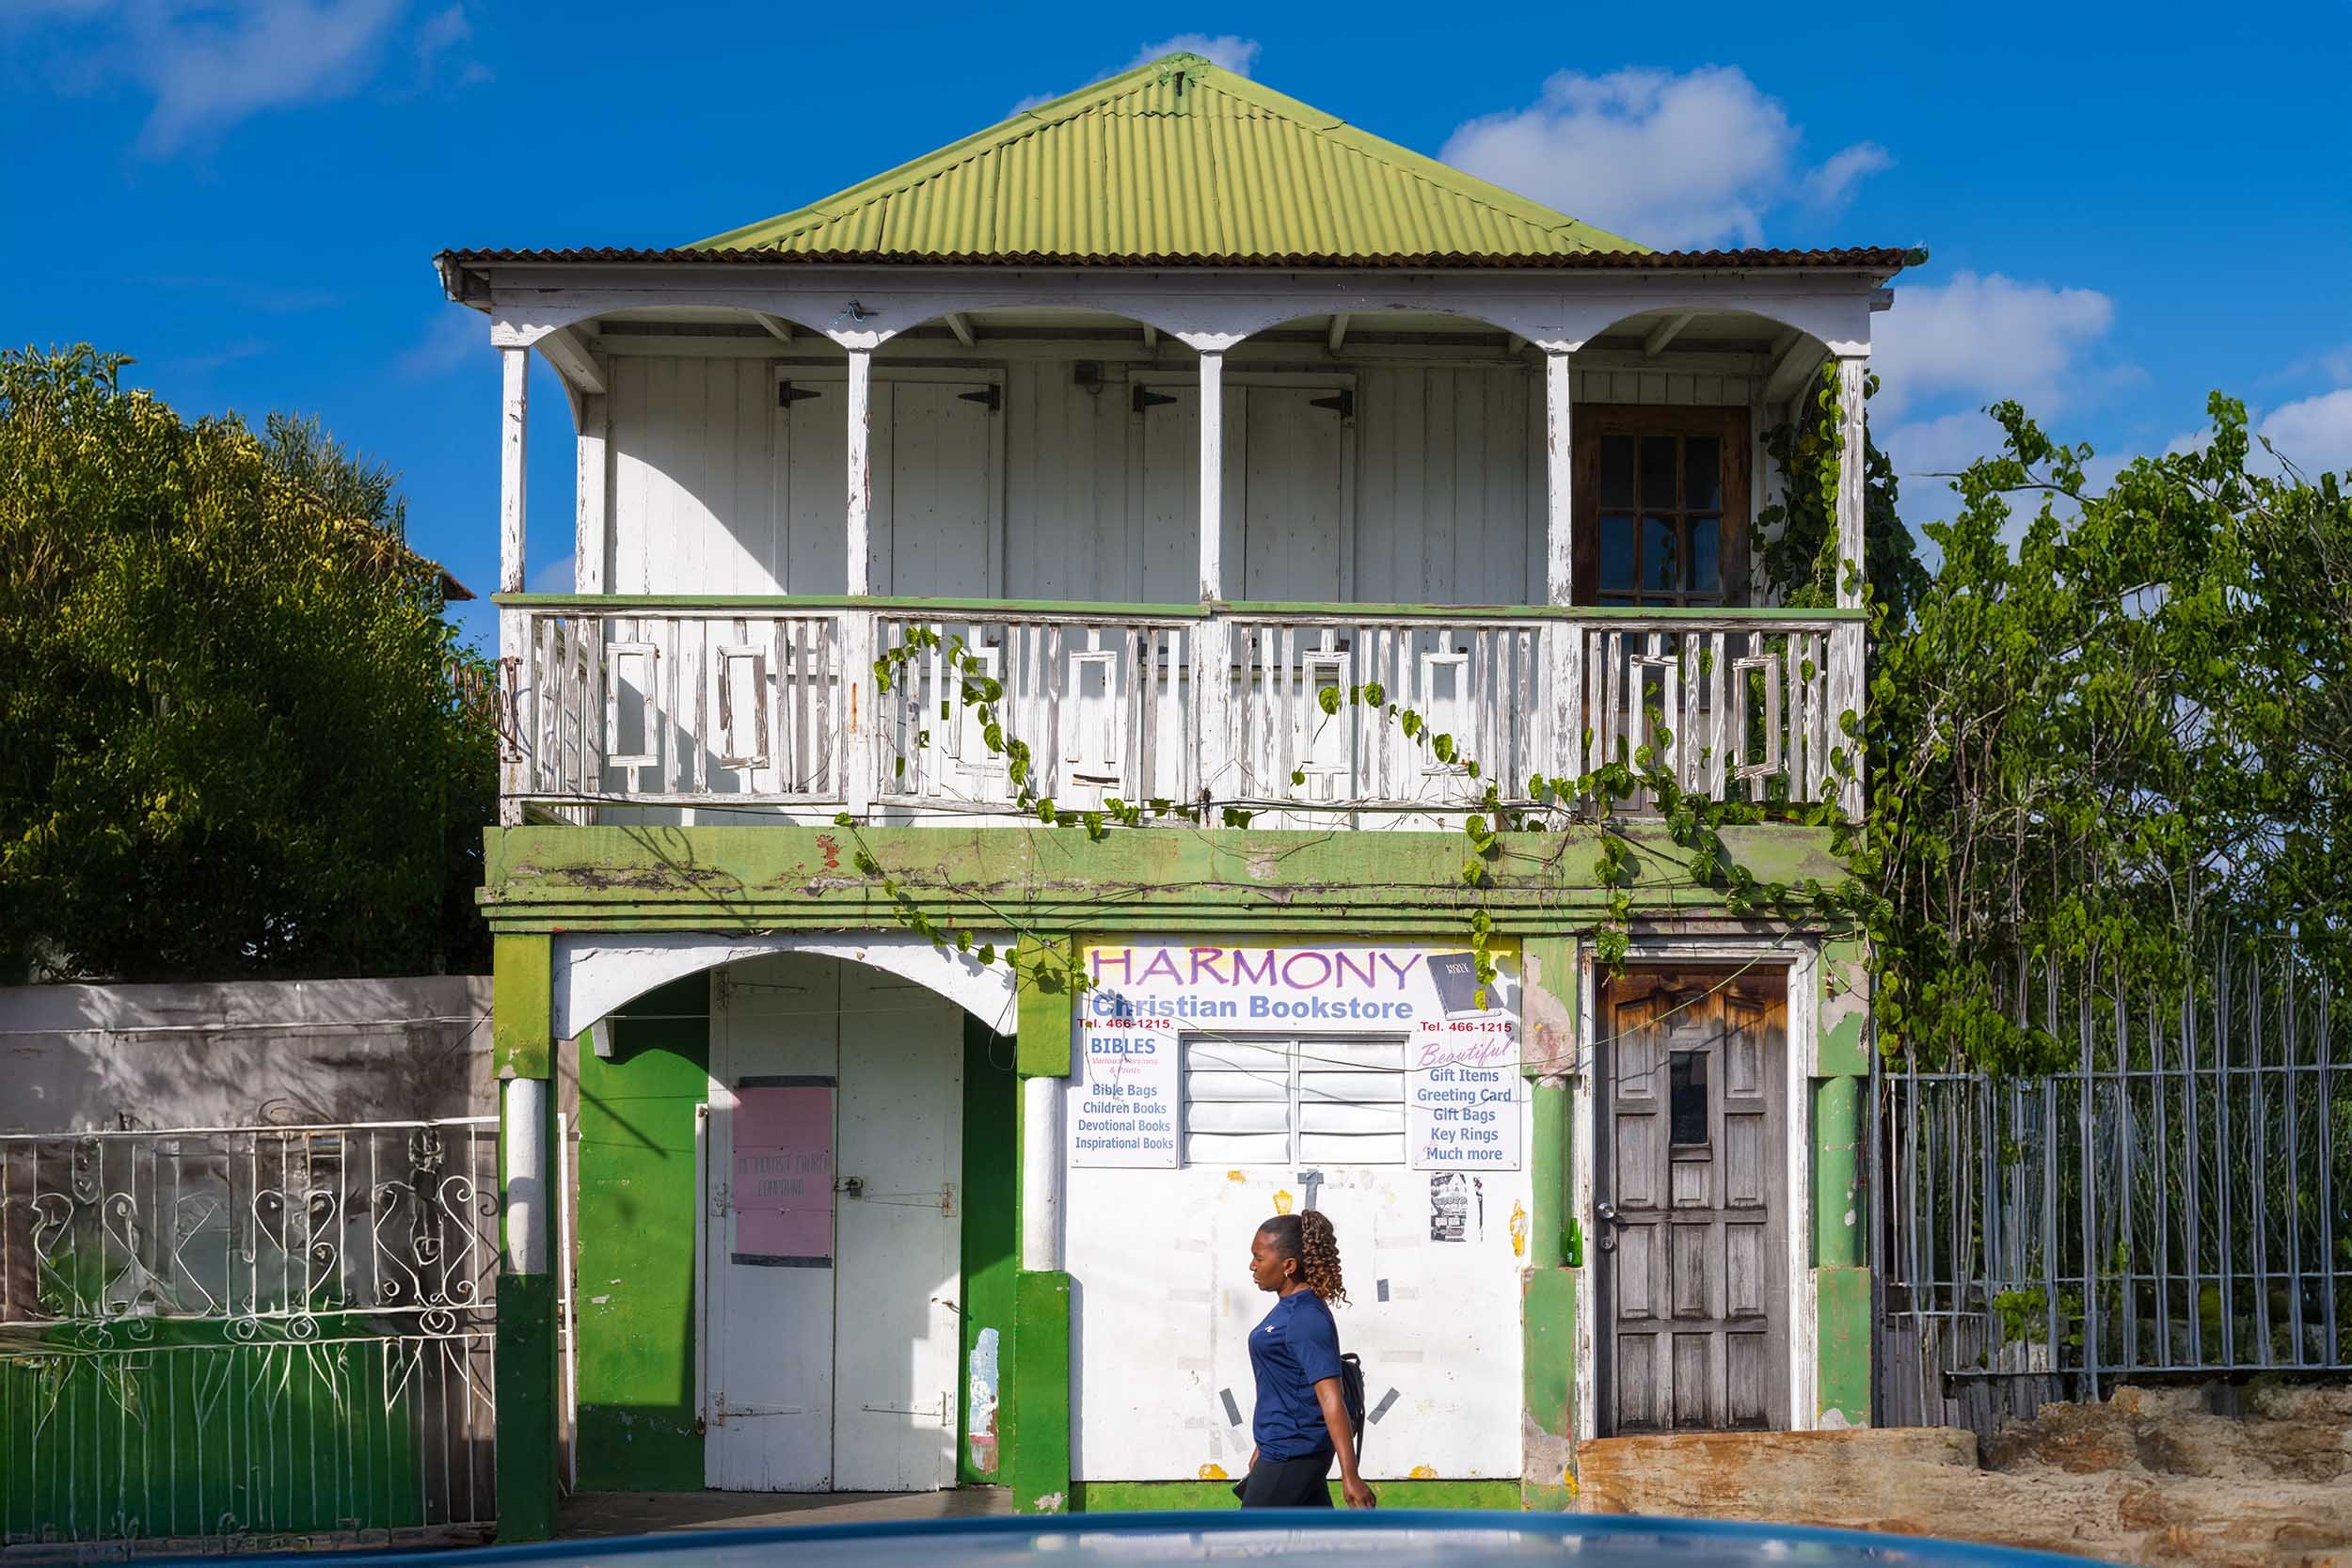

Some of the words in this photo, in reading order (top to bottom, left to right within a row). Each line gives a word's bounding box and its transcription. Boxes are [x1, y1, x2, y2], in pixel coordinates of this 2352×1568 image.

[1091, 948, 1422, 990] HARMONY
[1092, 992, 1237, 1018] Christian
[1249, 994, 1413, 1019] Bookstore
[1077, 1019, 1102, 1029] Tl.
[1105, 1019, 1170, 1029] 466-1215
[1420, 1022, 1444, 1032] Tel.
[1449, 1022, 1513, 1032] 466-1215
[1091, 1037, 1156, 1054] BIBLES
[1418, 1037, 1516, 1067] Beautiful
[1430, 1069, 1455, 1082] Gift
[1459, 1069, 1499, 1082] Items
[1092, 1084, 1124, 1096] Bible
[1127, 1085, 1157, 1099] Bags
[1417, 1087, 1476, 1104] Greeting
[1480, 1088, 1512, 1101] Card
[1083, 1101, 1130, 1114] Children
[1133, 1102, 1167, 1114] Books
[1433, 1108, 1458, 1121] Gift
[1463, 1108, 1496, 1124] Bags
[1078, 1119, 1136, 1131] Devotional
[1138, 1120, 1170, 1132] Books
[1431, 1128, 1456, 1143] Key
[1460, 1128, 1499, 1143] Rings
[1075, 1136, 1140, 1151] Inspirational
[1143, 1137, 1174, 1148] Books
[1426, 1147, 1463, 1160] Much
[1468, 1149, 1503, 1160] more
